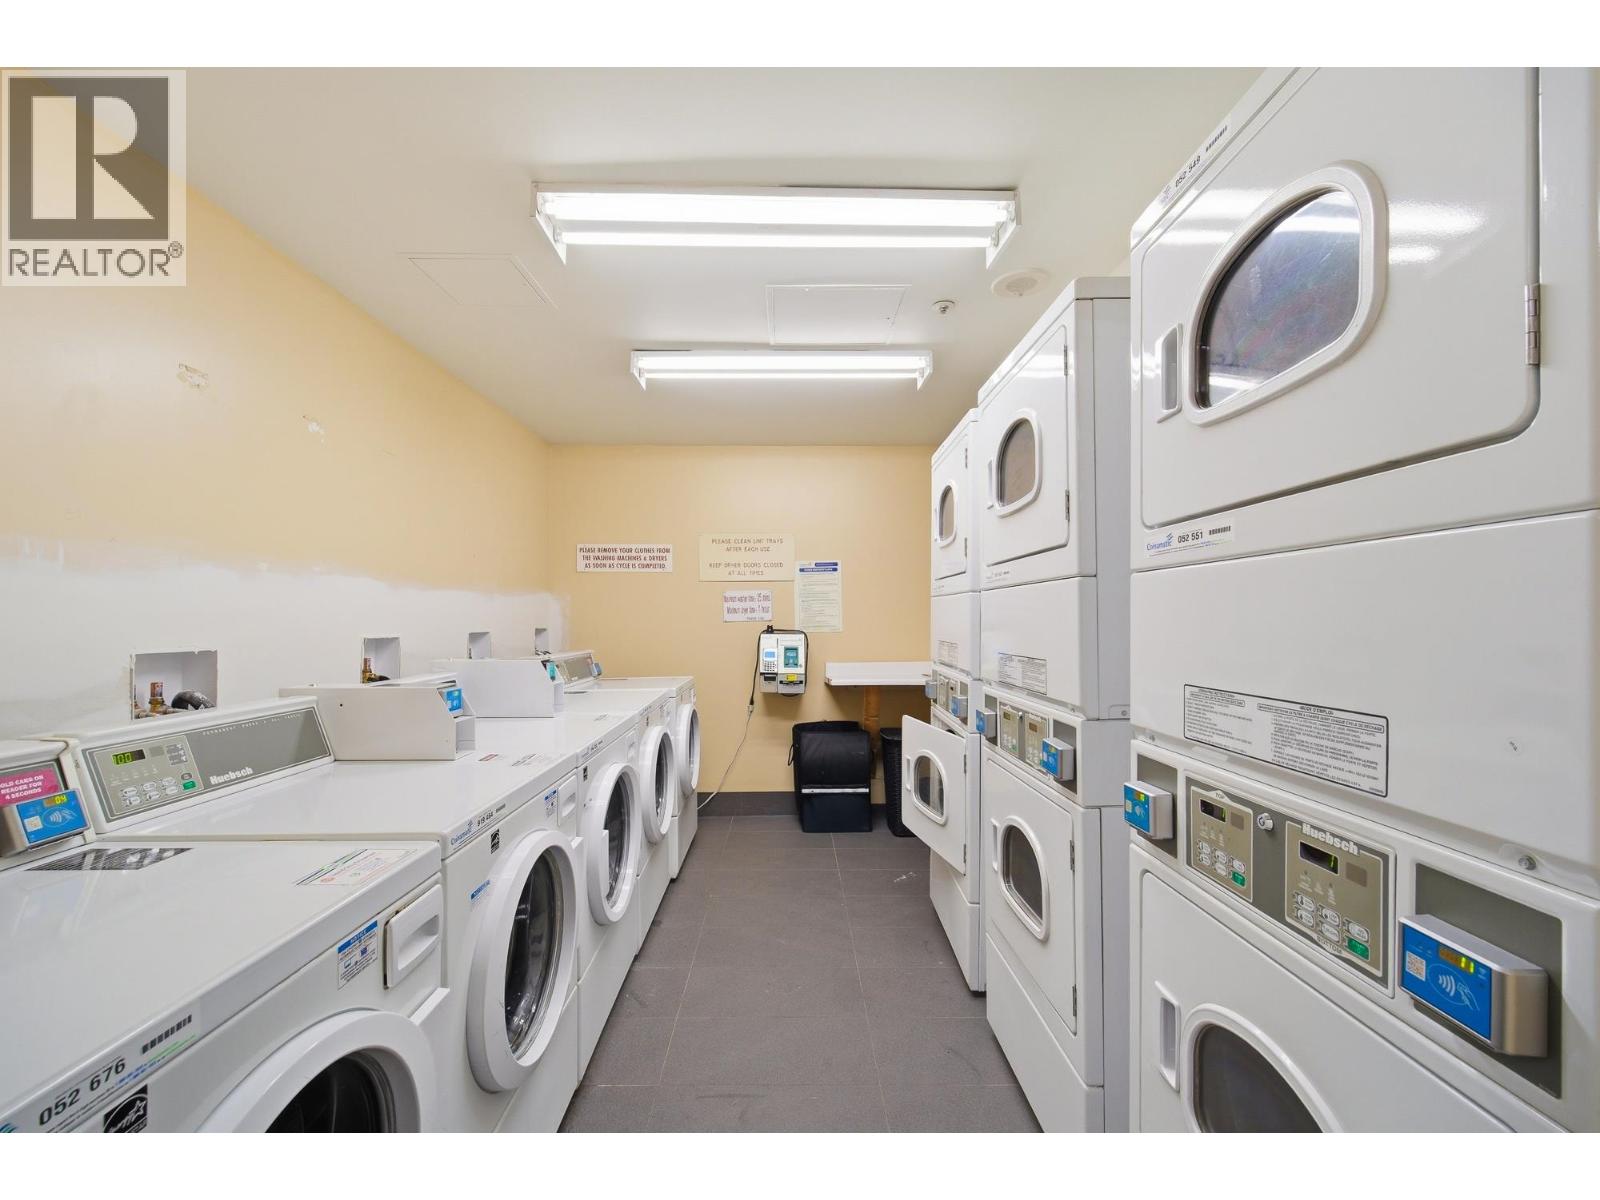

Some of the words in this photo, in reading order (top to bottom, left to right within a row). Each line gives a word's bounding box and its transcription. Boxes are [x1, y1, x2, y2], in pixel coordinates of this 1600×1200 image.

[1178, 534, 1190, 543] 052
[1191, 532, 1203, 540] 551
[210, 766, 253, 785] Huebsch
[0, 784, 28, 794] READER
[11, 788, 42, 798] SECONDS
[1302, 823, 1359, 856] Huebsch
[39, 1088, 81, 1126] 052
[89, 1058, 127, 1092] 676
